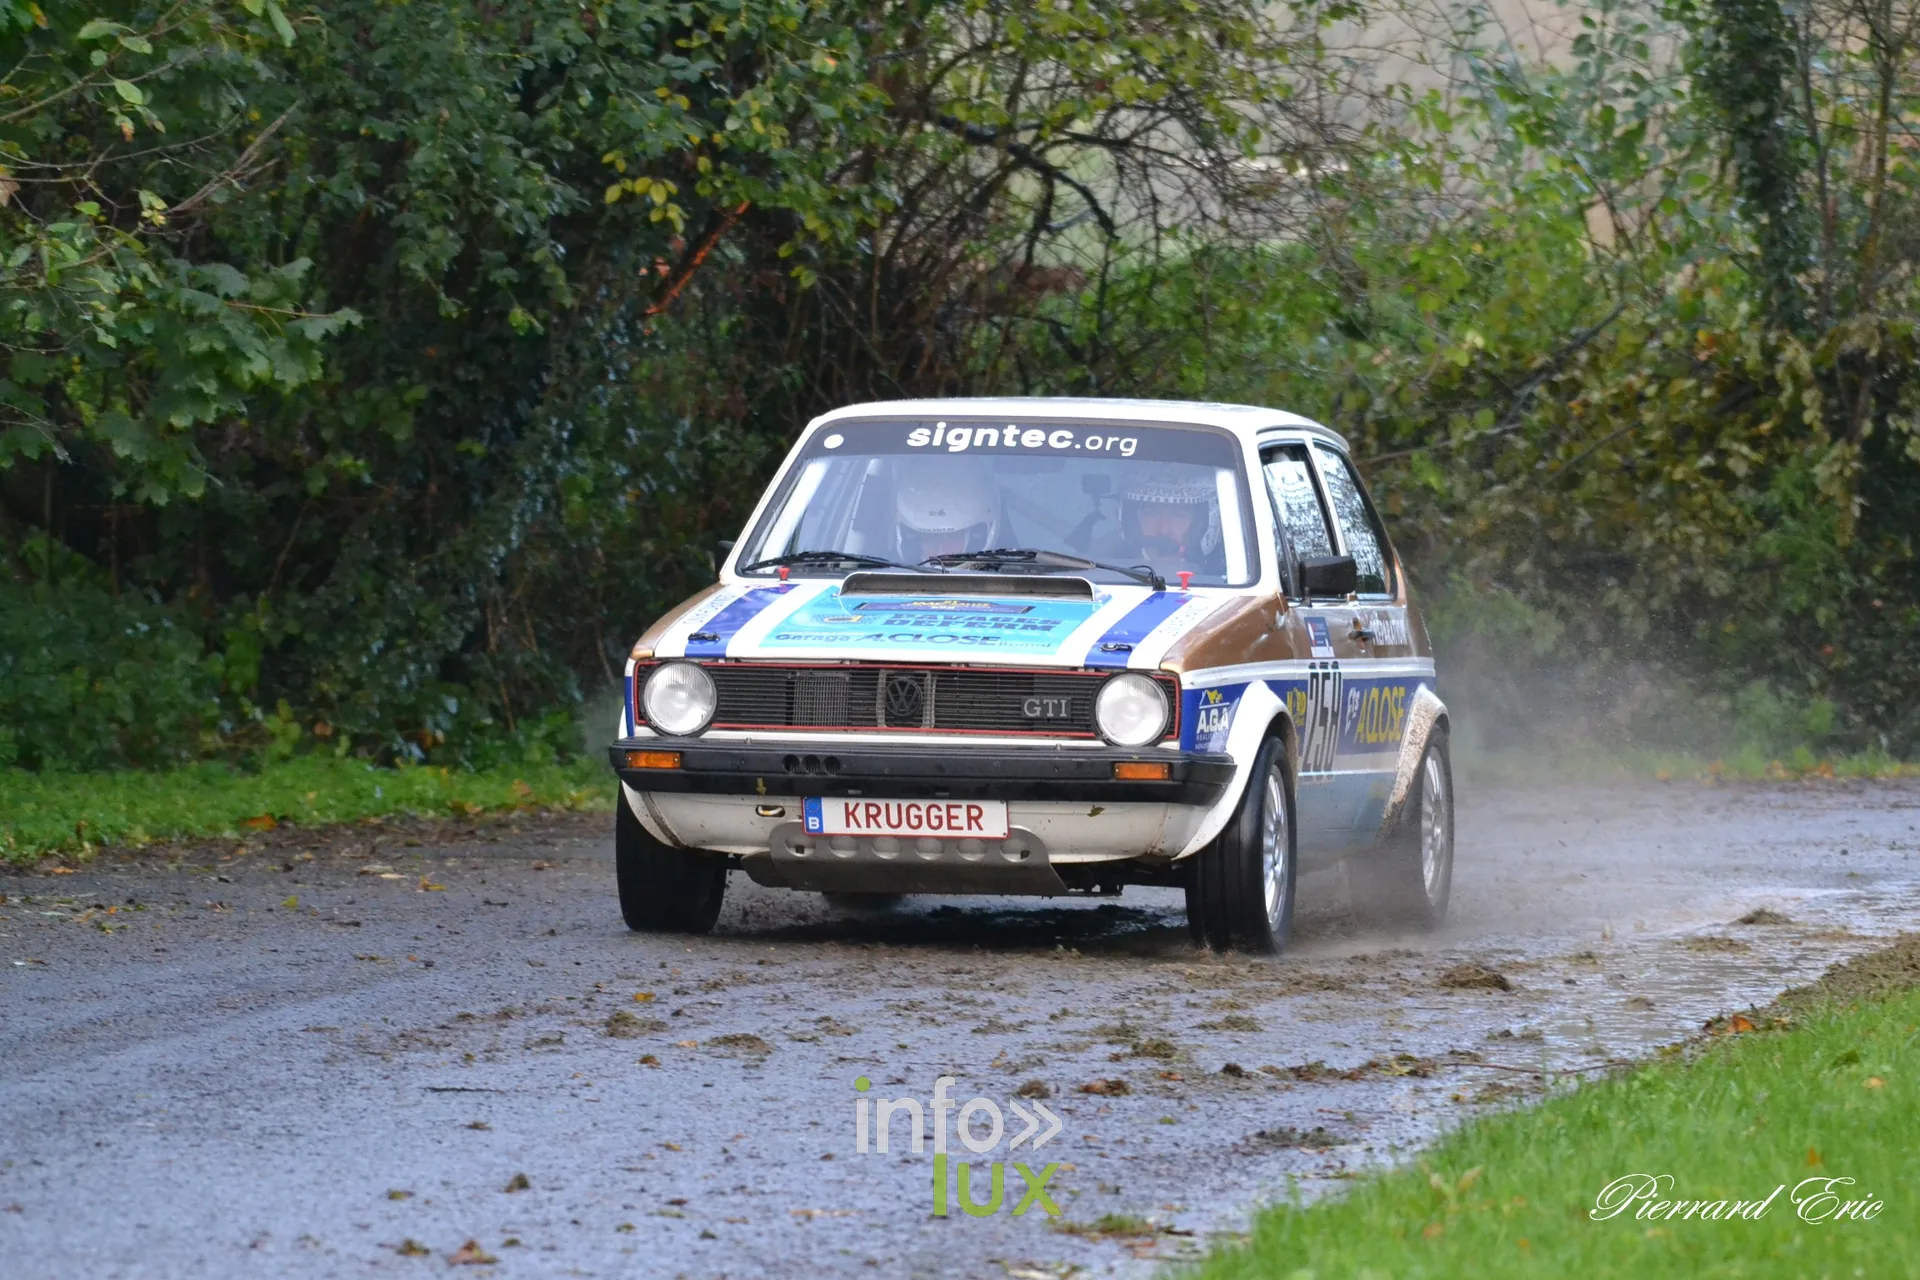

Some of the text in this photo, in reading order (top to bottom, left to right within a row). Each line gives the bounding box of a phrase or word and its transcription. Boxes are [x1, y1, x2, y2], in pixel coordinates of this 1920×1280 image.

[907, 422, 1138, 456] signtec.org
[882, 619, 1057, 632] DEFERM
[891, 613, 1063, 625] PAVAGES
[775, 633, 851, 642] Garage
[855, 632, 1001, 646] A.CLOSE
[1023, 698, 1068, 717] GTI
[808, 817, 820, 830] B
[844, 802, 984, 831] KRUGGER
